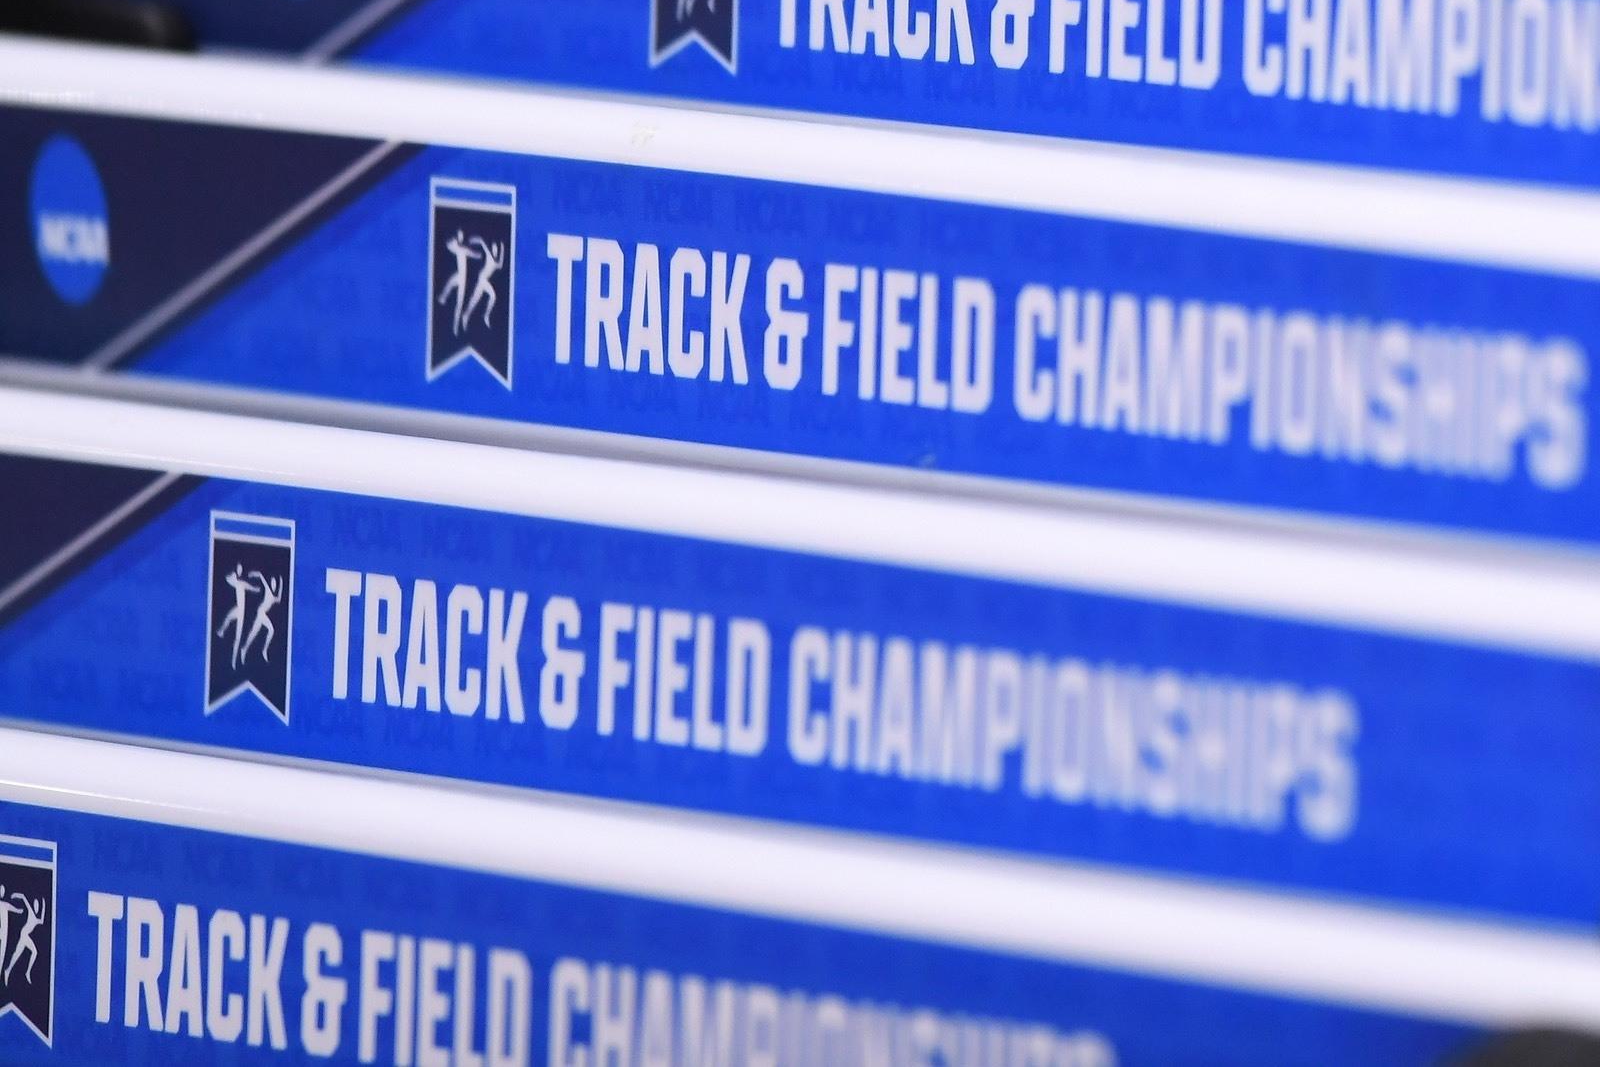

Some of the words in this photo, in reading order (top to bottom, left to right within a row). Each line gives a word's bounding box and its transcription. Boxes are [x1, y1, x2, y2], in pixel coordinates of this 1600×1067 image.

[547, 233, 751, 385] TRACK
[763, 257, 809, 391] &
[822, 263, 995, 413] FIELD
[1014, 285, 1584, 486] CHAMPIONSHIPS
[325, 568, 528, 723] TRACK
[539, 596, 585, 729] &
[597, 603, 771, 755] FIELD
[788, 628, 1353, 836] CHAMPIONSHIPS
[87, 890, 289, 1050] TRACK
[301, 923, 347, 1056] &
[359, 931, 531, 1067] FIELD
